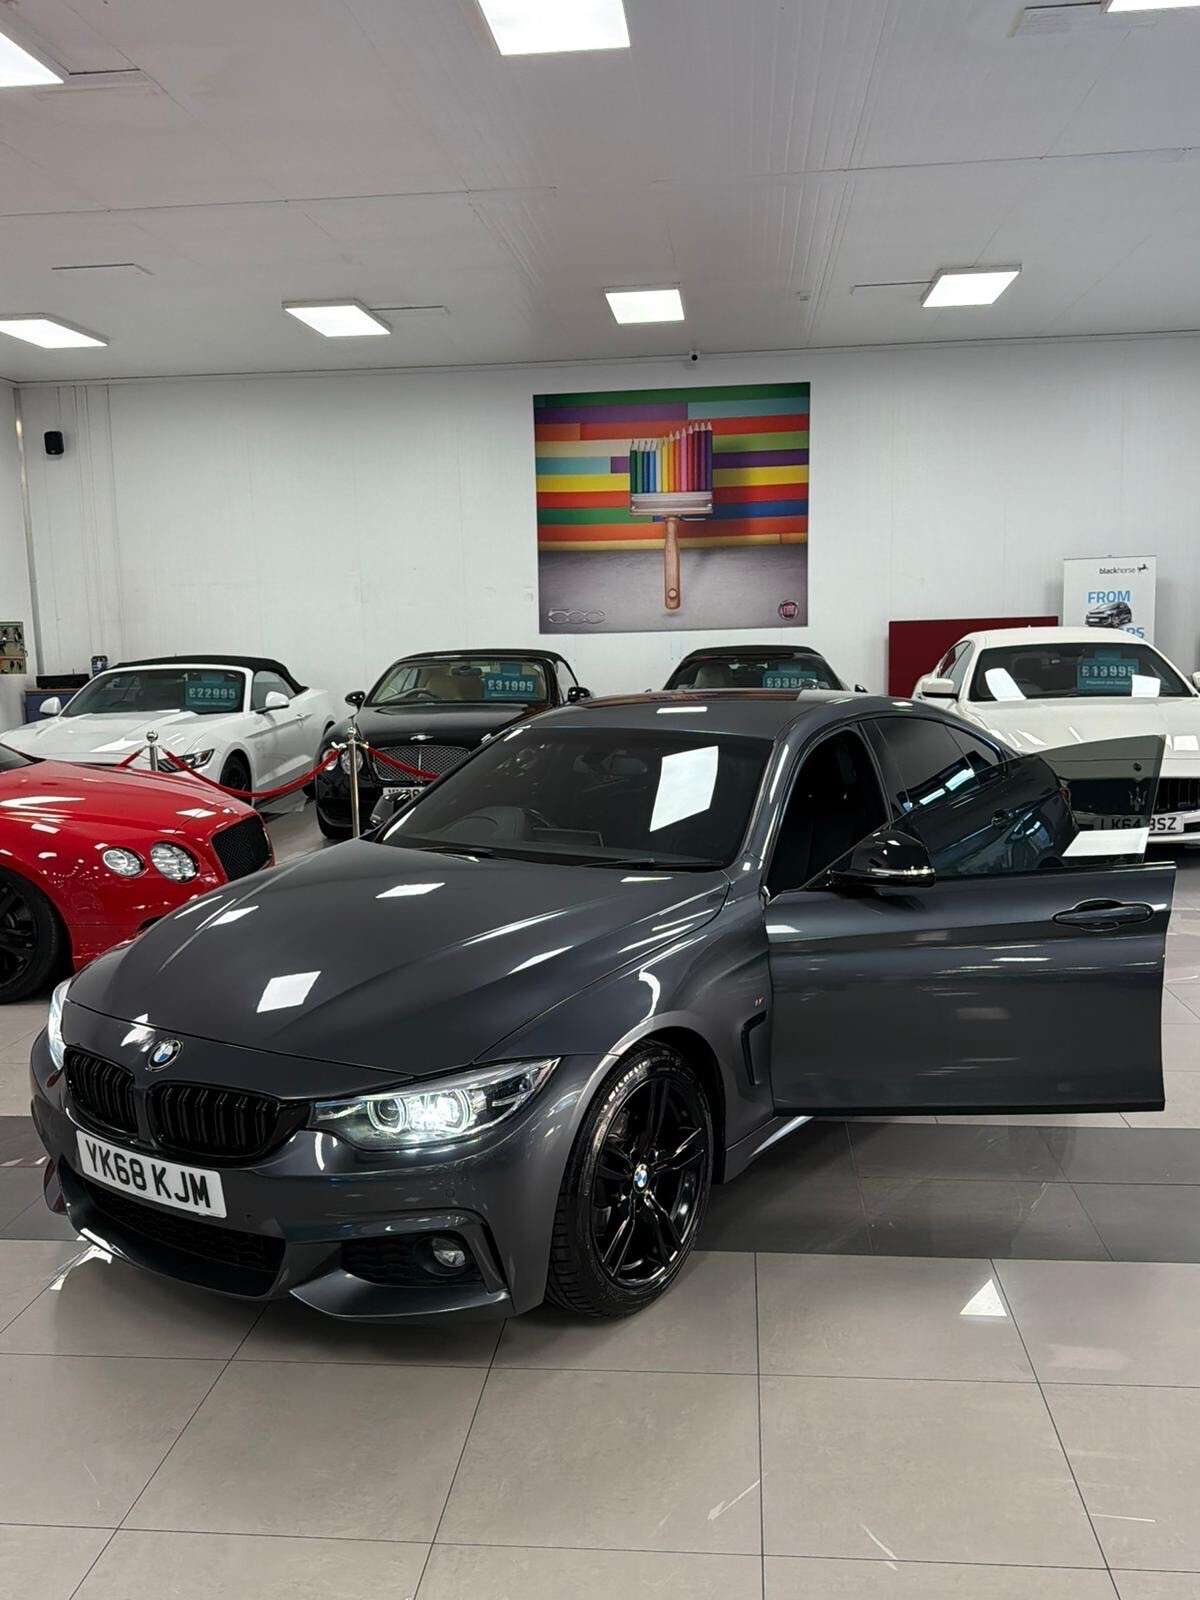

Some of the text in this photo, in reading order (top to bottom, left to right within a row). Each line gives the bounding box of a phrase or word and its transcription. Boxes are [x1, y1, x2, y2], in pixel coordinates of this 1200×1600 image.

[1087, 590, 1131, 604] FROM
[1081, 665, 1136, 677] £13995
[488, 679, 534, 692] £31995
[189, 687, 236, 699] £22995
[85, 1139, 211, 1208] YK68 KJM
